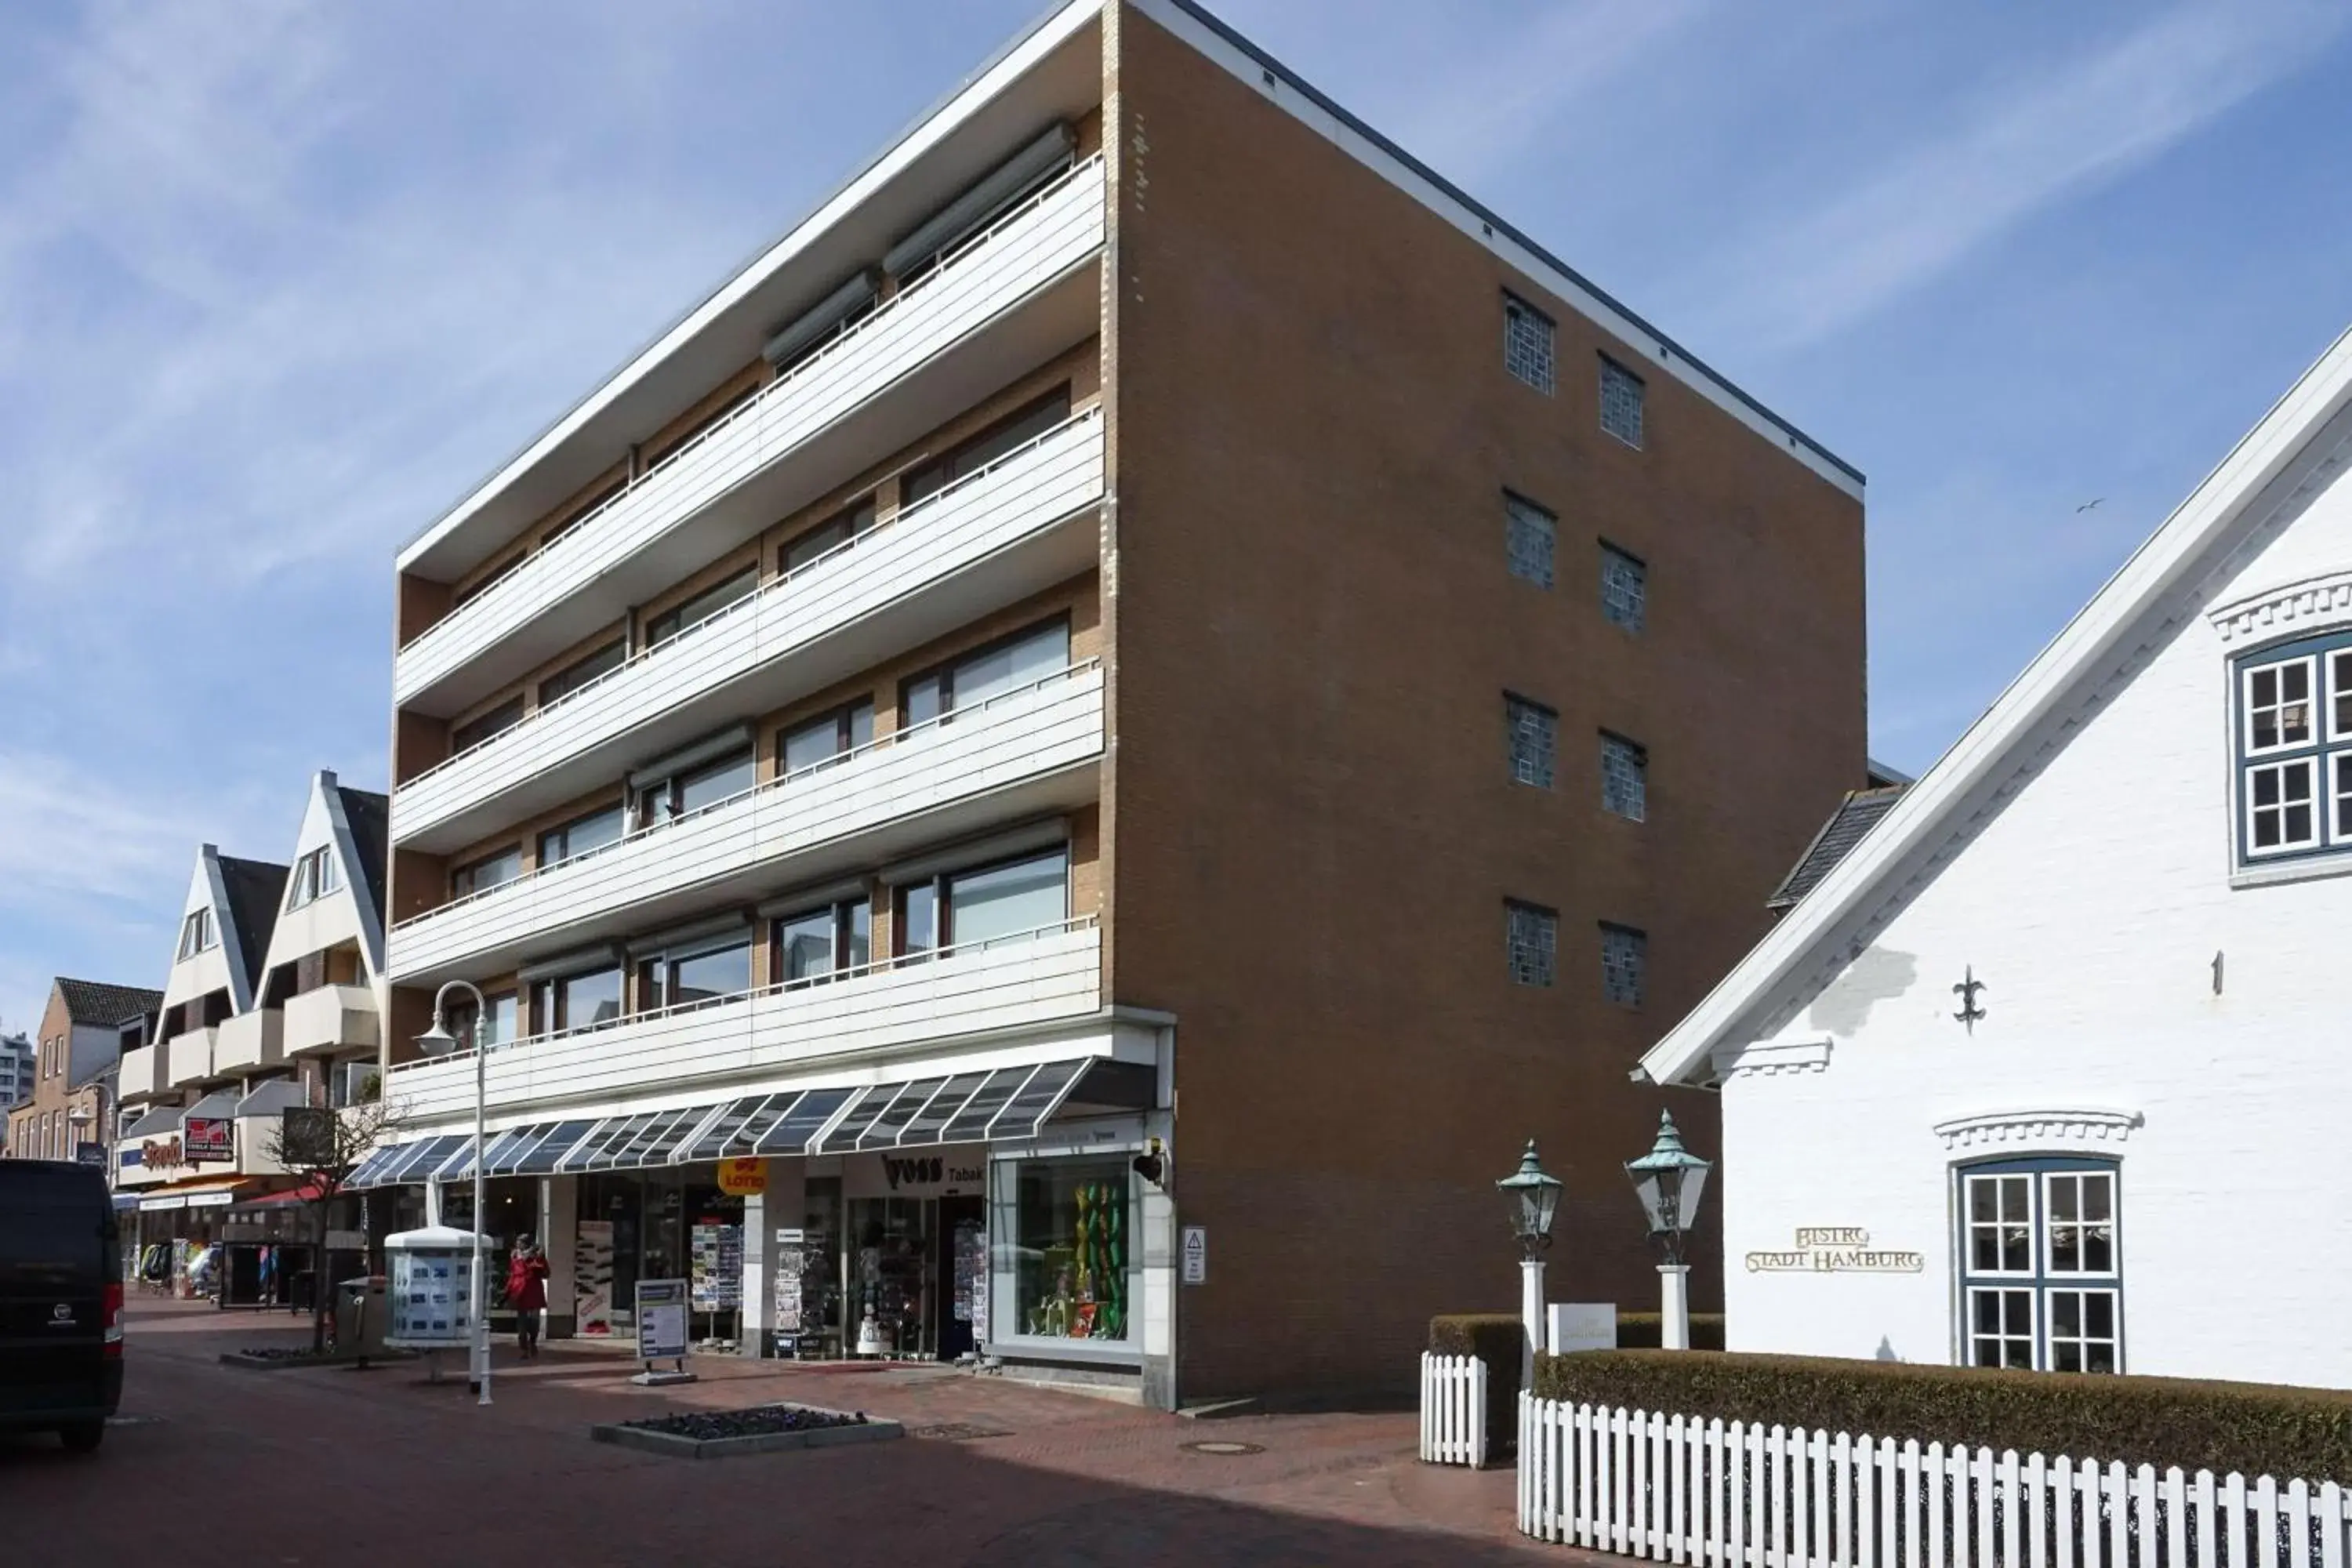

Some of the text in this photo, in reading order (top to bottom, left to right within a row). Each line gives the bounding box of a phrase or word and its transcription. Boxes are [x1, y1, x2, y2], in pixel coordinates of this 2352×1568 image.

[725, 1175, 765, 1188] LOTTO
[948, 1166, 985, 1182] Tabak
[1795, 1227, 1869, 1249] BISTRO
[1745, 1251, 1925, 1273] STADT HAMBURG
